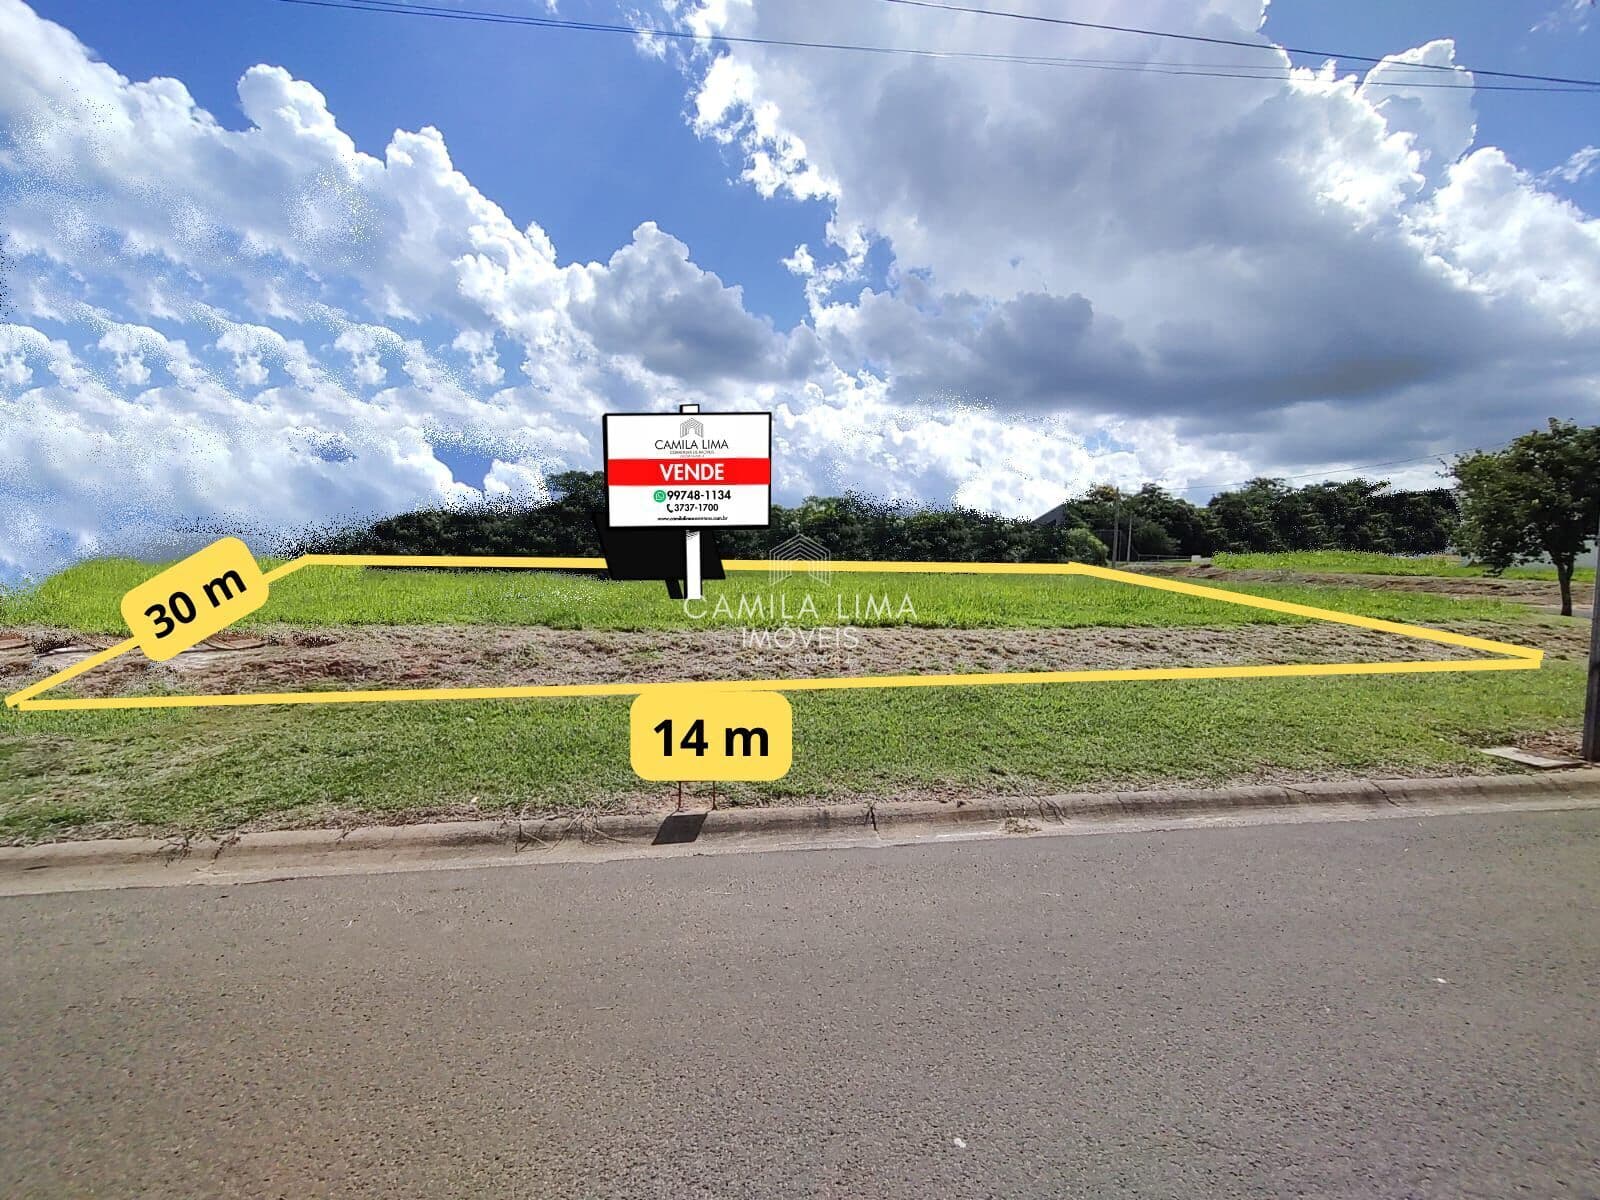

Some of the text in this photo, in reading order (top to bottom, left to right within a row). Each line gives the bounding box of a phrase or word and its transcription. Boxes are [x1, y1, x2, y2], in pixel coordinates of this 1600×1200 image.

[654, 439, 729, 450] CAMILA LIMA
[659, 463, 725, 481] VENDE
[667, 489, 731, 501] 99748-1134
[674, 503, 719, 512] 3737-1700
